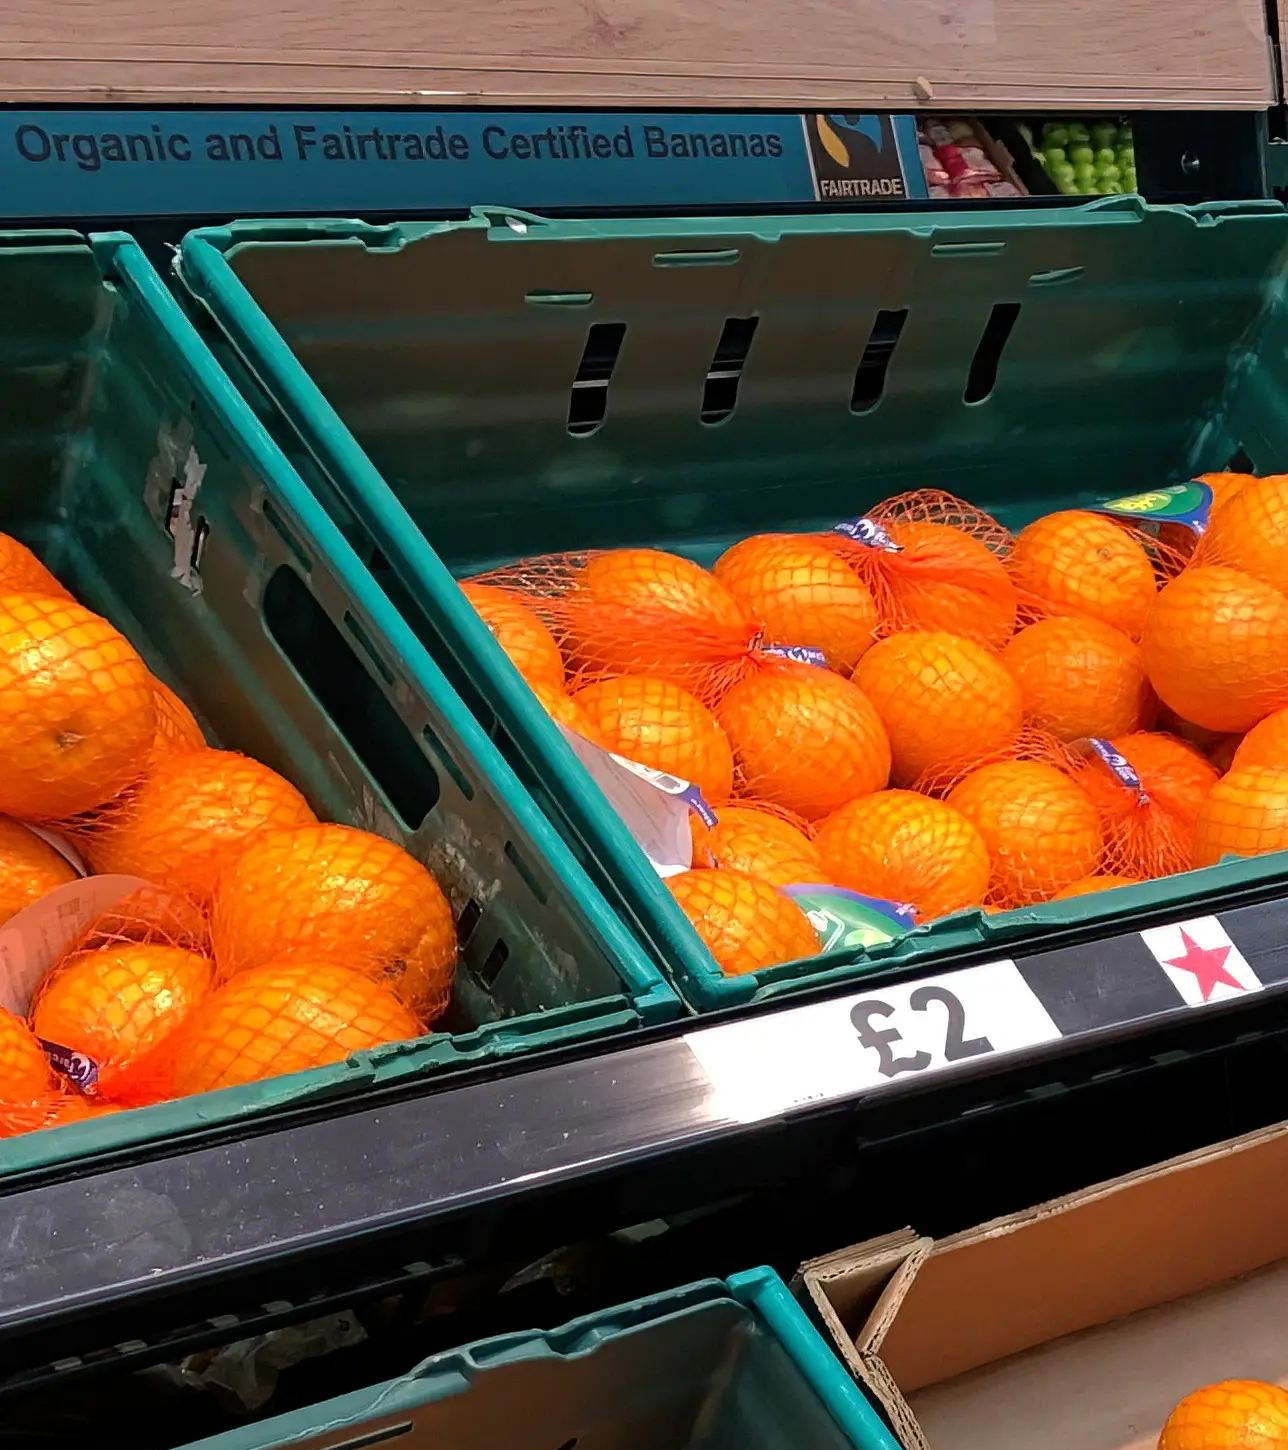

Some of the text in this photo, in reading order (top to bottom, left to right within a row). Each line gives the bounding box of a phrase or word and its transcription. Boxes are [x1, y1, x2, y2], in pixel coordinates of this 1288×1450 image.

[15, 124, 783, 171] Organic and Fairtrade Certified Bananas
[820, 178, 904, 196] FAIRTRADE
[848, 985, 996, 1078] £2
